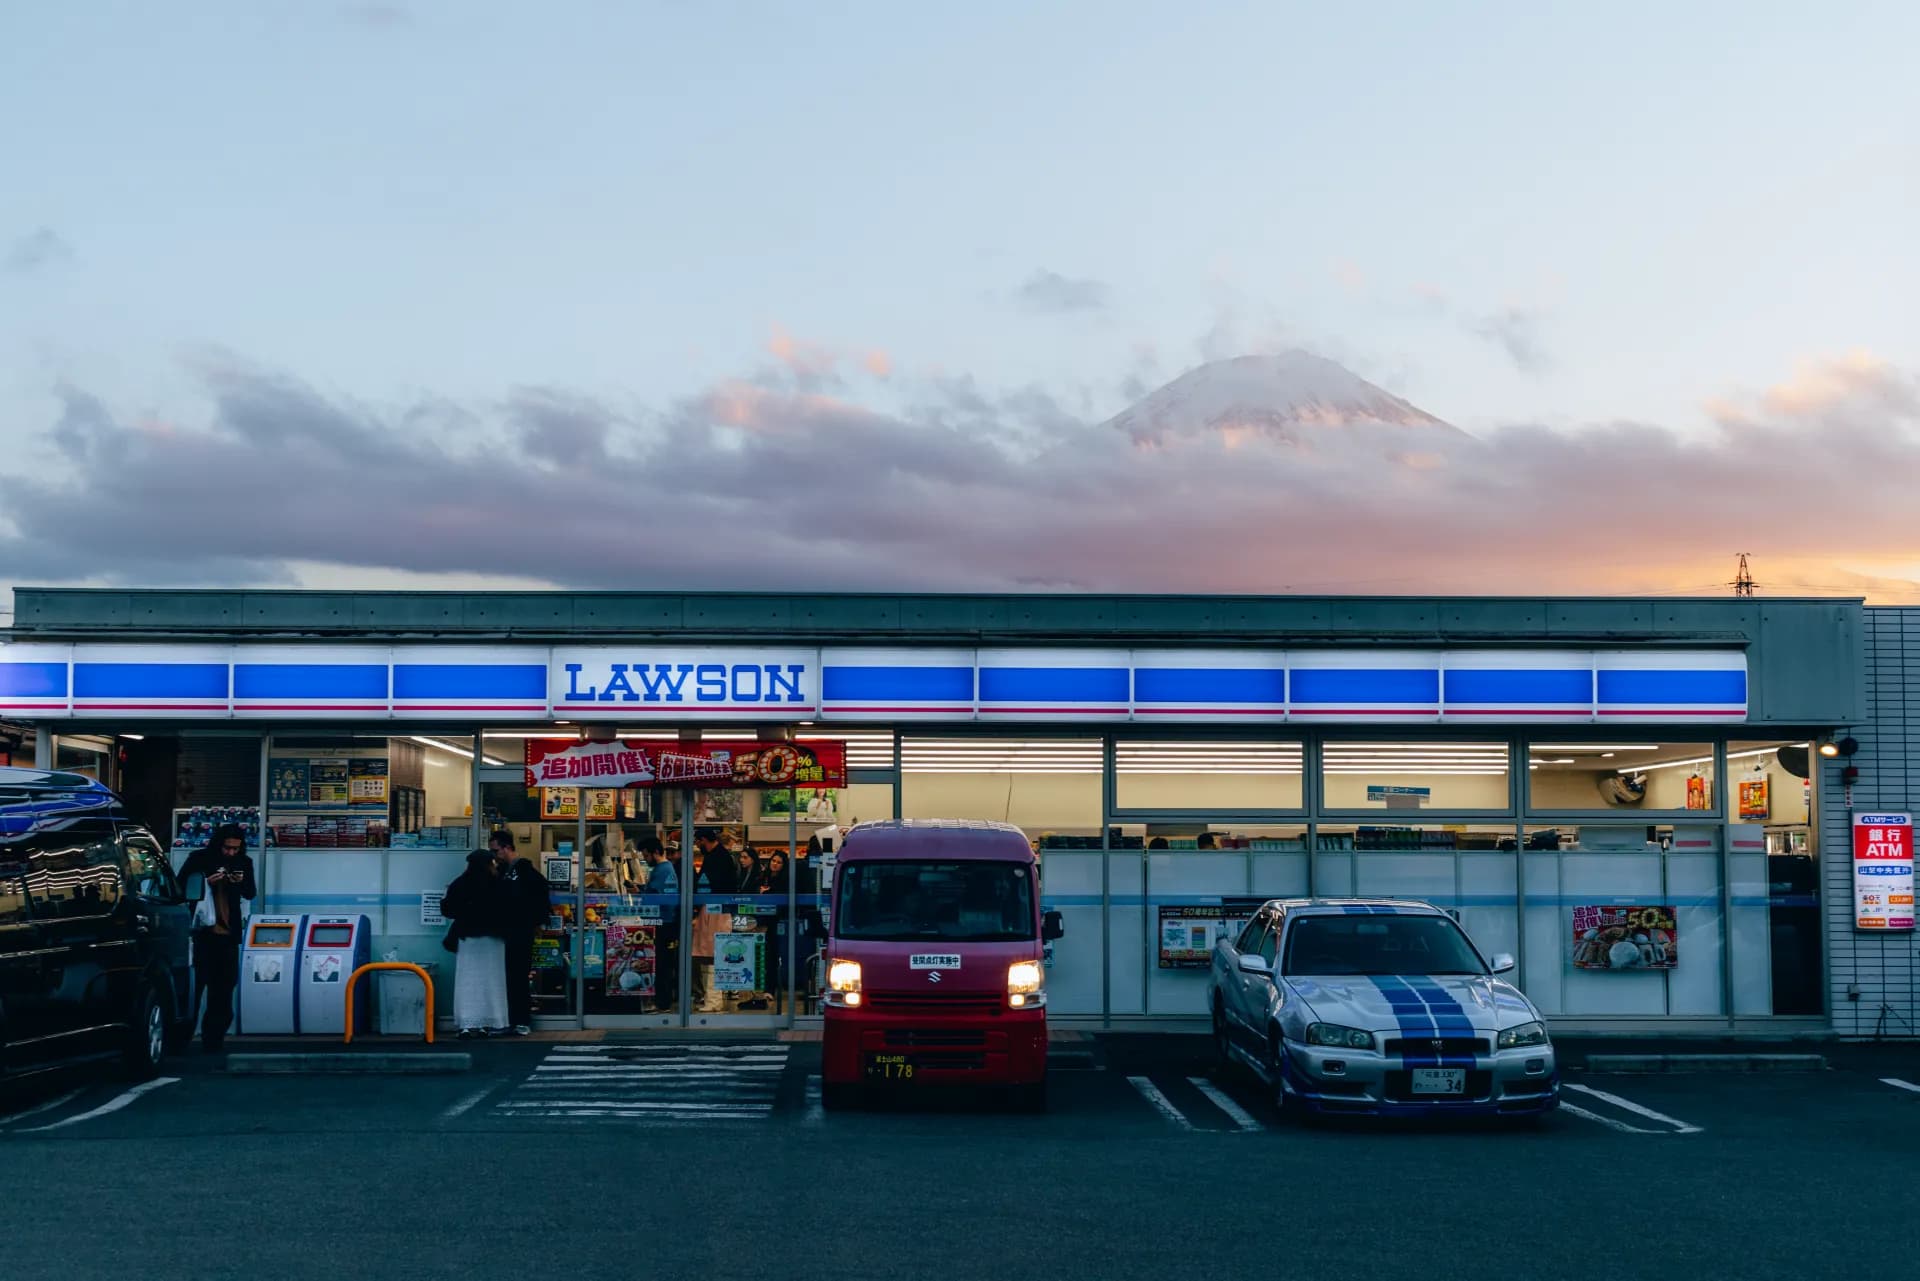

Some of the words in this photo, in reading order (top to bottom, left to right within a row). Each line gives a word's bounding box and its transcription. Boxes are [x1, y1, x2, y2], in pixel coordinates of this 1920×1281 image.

[565, 664, 804, 702] LAWSON
[541, 751, 650, 780] 追加開催!
[661, 757, 730, 778] お値段そのまま
[795, 765, 824, 782] 増量
[1868, 828, 1901, 842] 銀行
[1866, 843, 1903, 856] ATM
[734, 916, 747, 926] 24
[1445, 1079, 1462, 1092] 34
